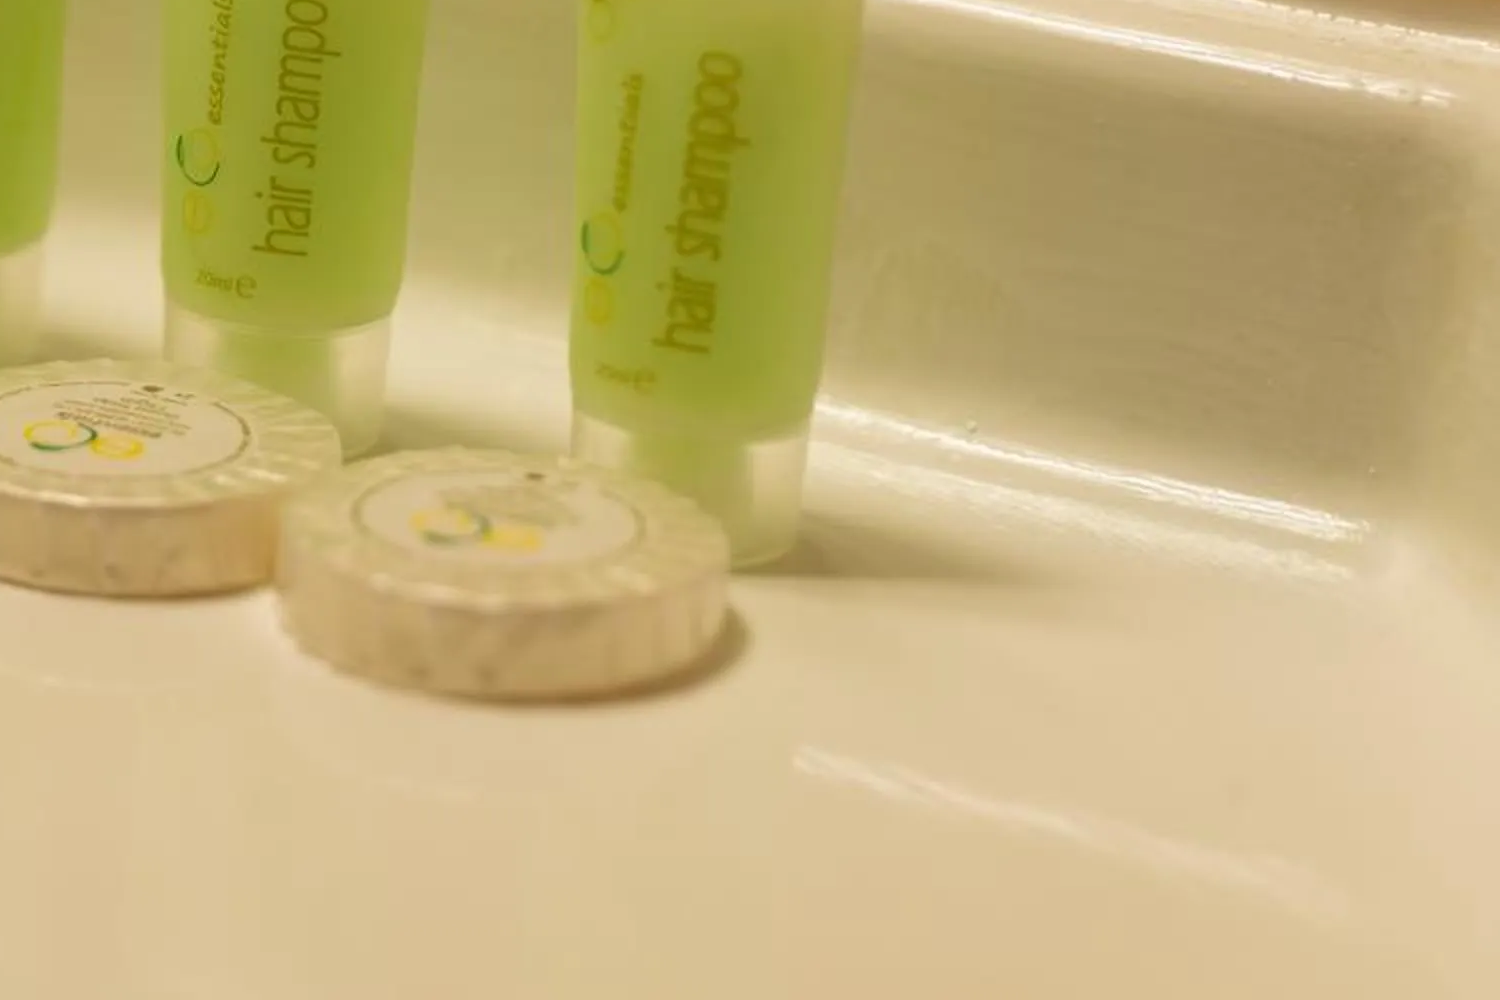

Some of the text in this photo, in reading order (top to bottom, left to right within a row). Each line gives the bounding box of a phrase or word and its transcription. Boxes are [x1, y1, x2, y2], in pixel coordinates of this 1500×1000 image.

[250, 175, 313, 258] hair
[650, 51, 751, 355] hair shampoo
